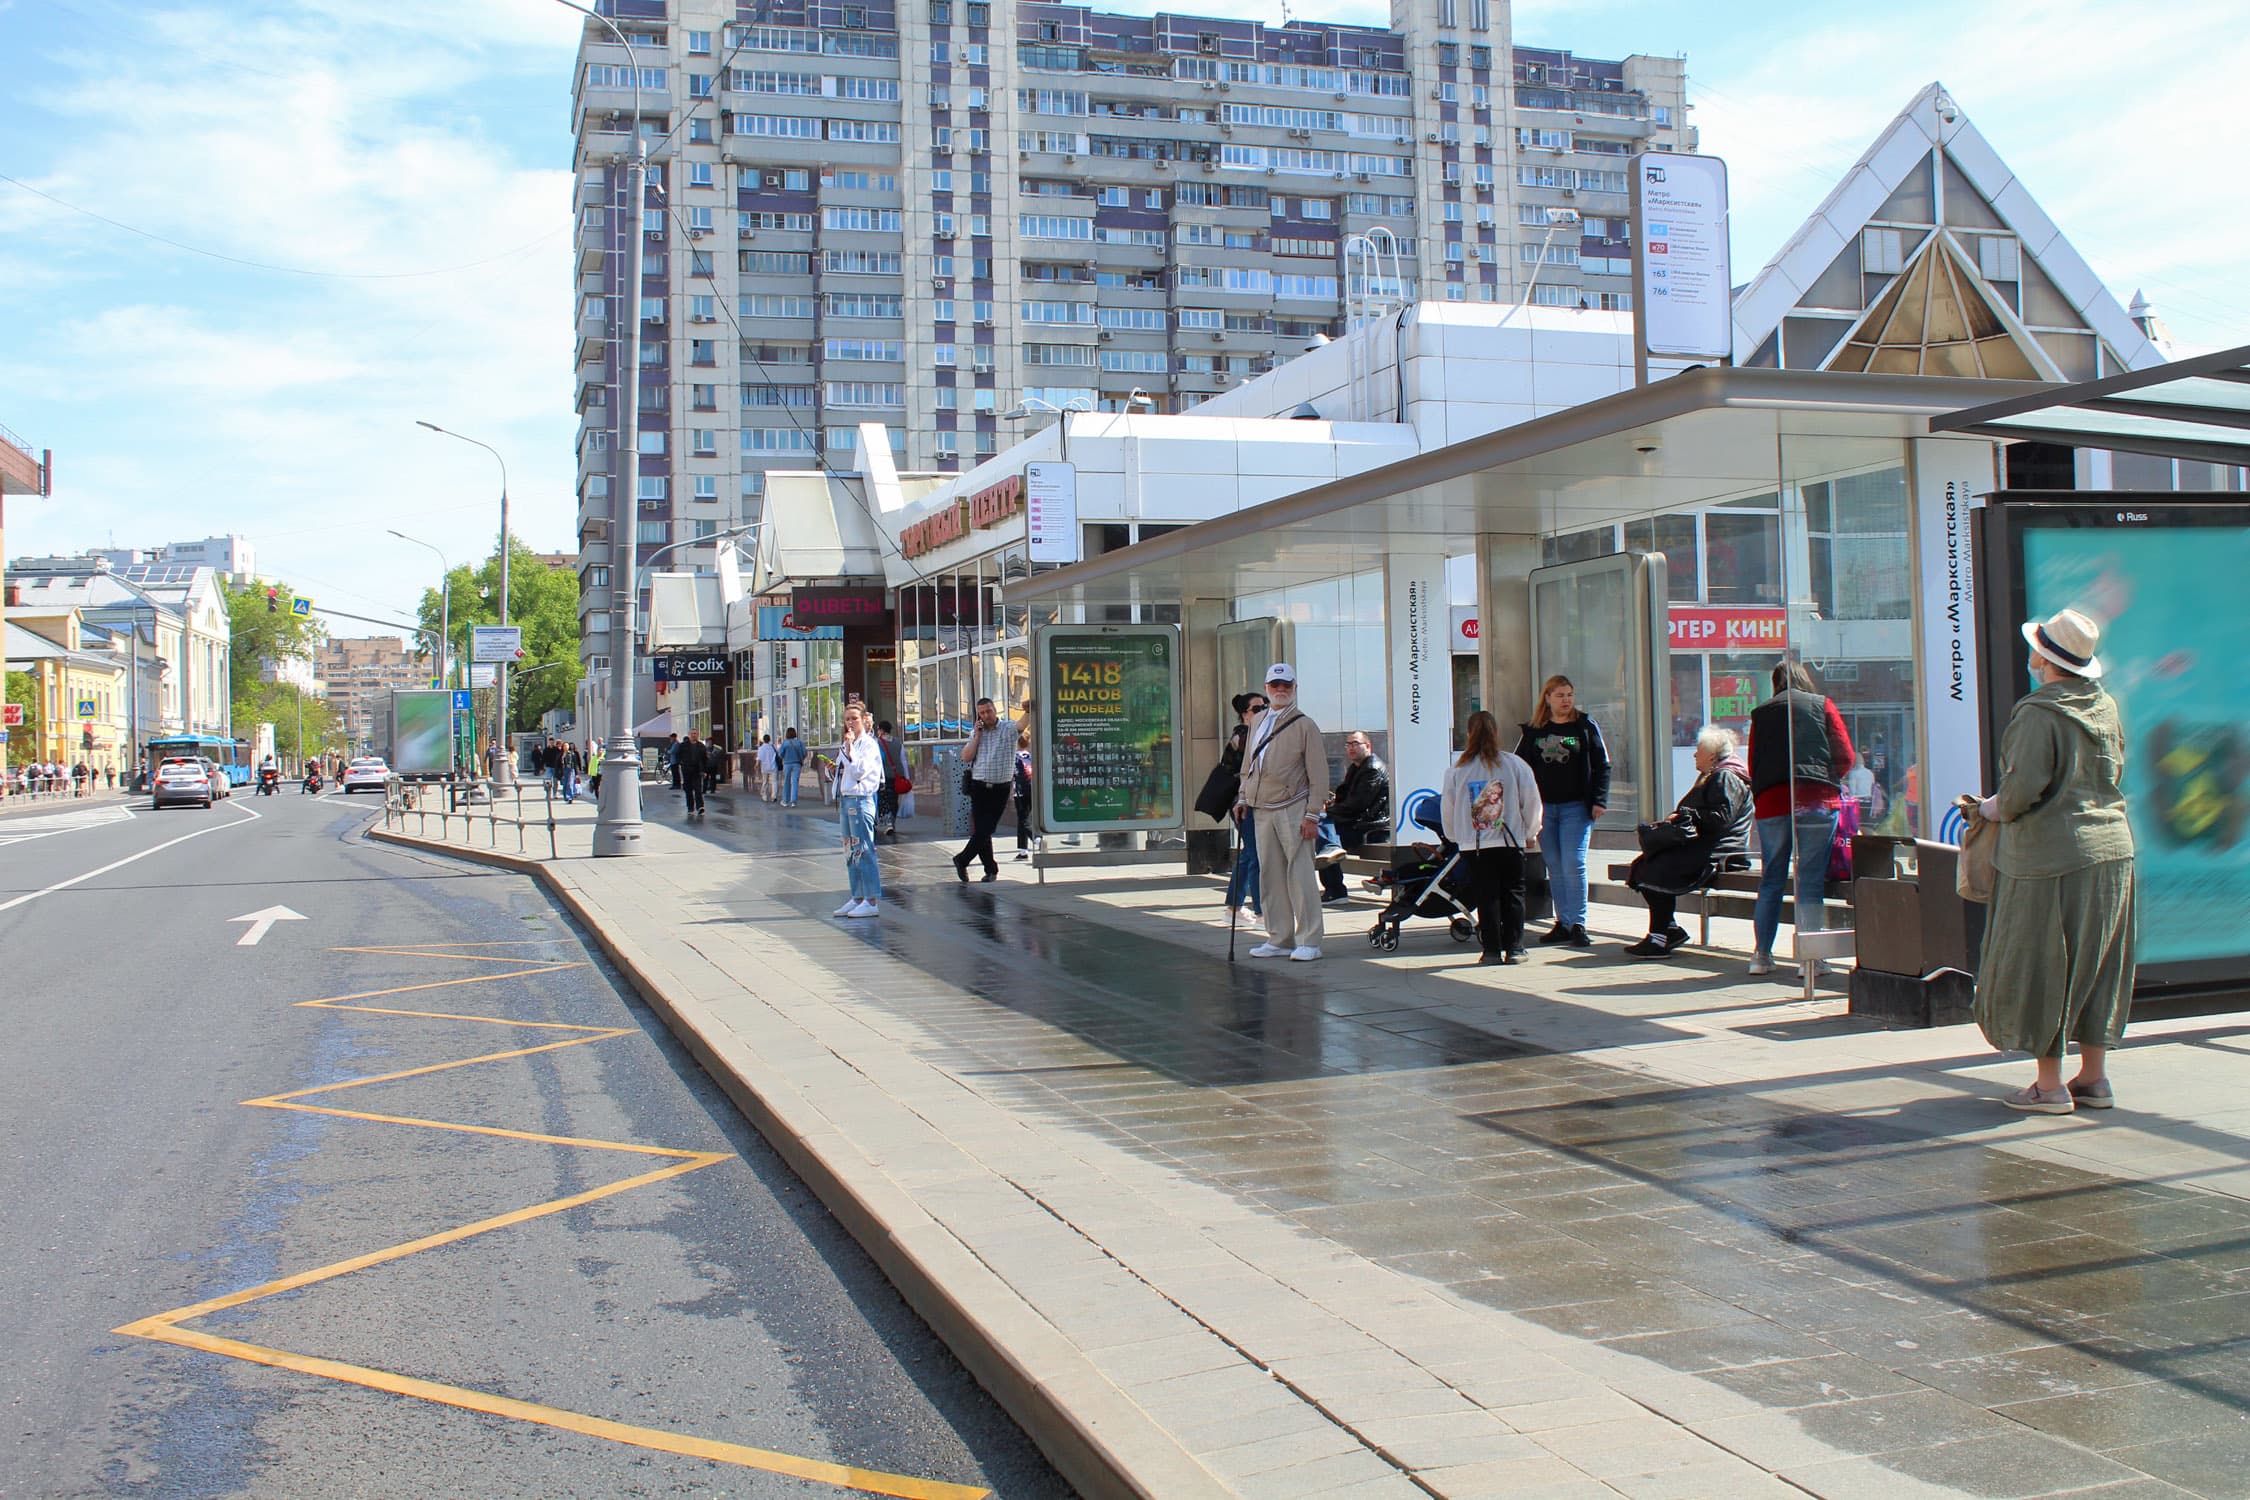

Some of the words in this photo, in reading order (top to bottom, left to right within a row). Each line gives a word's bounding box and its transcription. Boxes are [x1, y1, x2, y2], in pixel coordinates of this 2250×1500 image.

[1653, 287, 1668, 295] 766
[970, 475, 1020, 530] ЦЕНТР
[1961, 480, 1972, 565] Marksistskaya
[2126, 512, 2148, 521] Russ
[1946, 480, 1962, 634] «Марксистская»
[1964, 567, 1973, 604] Metro
[813, 598, 881, 616] ЦВЕТЫ
[1408, 580, 1421, 680] «Марксистская»
[1726, 619, 1786, 638] КИНГ
[687, 658, 725, 671] cofix
[1058, 662, 1121, 685] 1418
[1949, 639, 1964, 702] Метро
[1058, 688, 1121, 701] ШАГОВ
[1735, 678, 1752, 695] 24
[1058, 704, 1067, 714] К
[1070, 704, 1121, 715] ПОБЕДЕ
[1410, 683, 1421, 725] Метро
